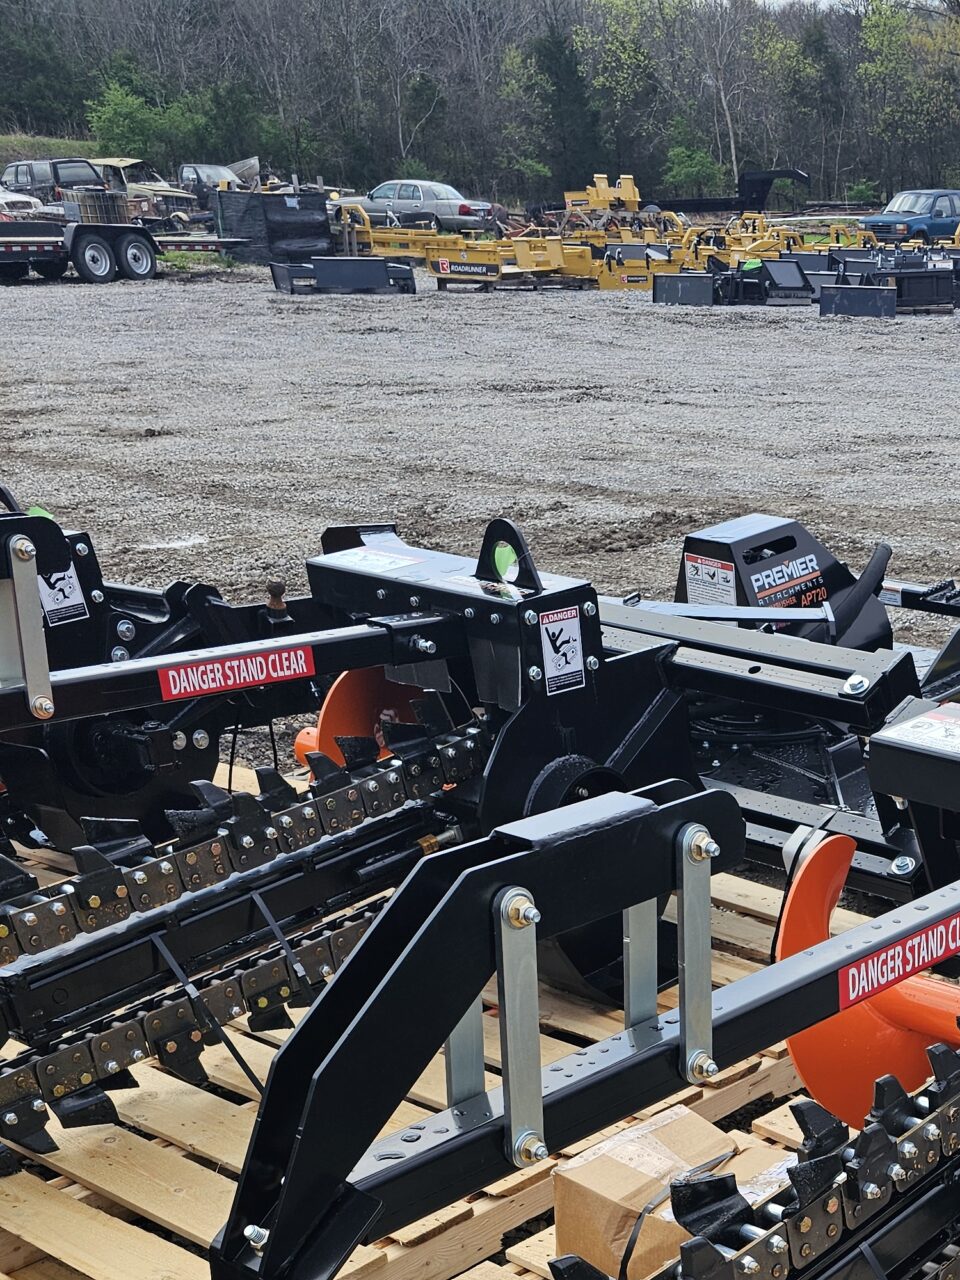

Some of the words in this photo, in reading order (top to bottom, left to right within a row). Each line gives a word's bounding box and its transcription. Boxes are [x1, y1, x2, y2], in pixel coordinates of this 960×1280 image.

[451, 265, 487, 274] ROADRUNNER
[750, 553, 820, 593] PREMIER
[758, 577, 824, 606] ATTACHMENTS
[801, 587, 828, 608] AP720
[548, 610, 577, 623] DANGER
[168, 662, 224, 695] DANGER
[224, 656, 267, 686] STAND
[268, 650, 307, 678] CLEAR
[849, 945, 903, 1001] DANGER
[905, 925, 946, 973] STAND
